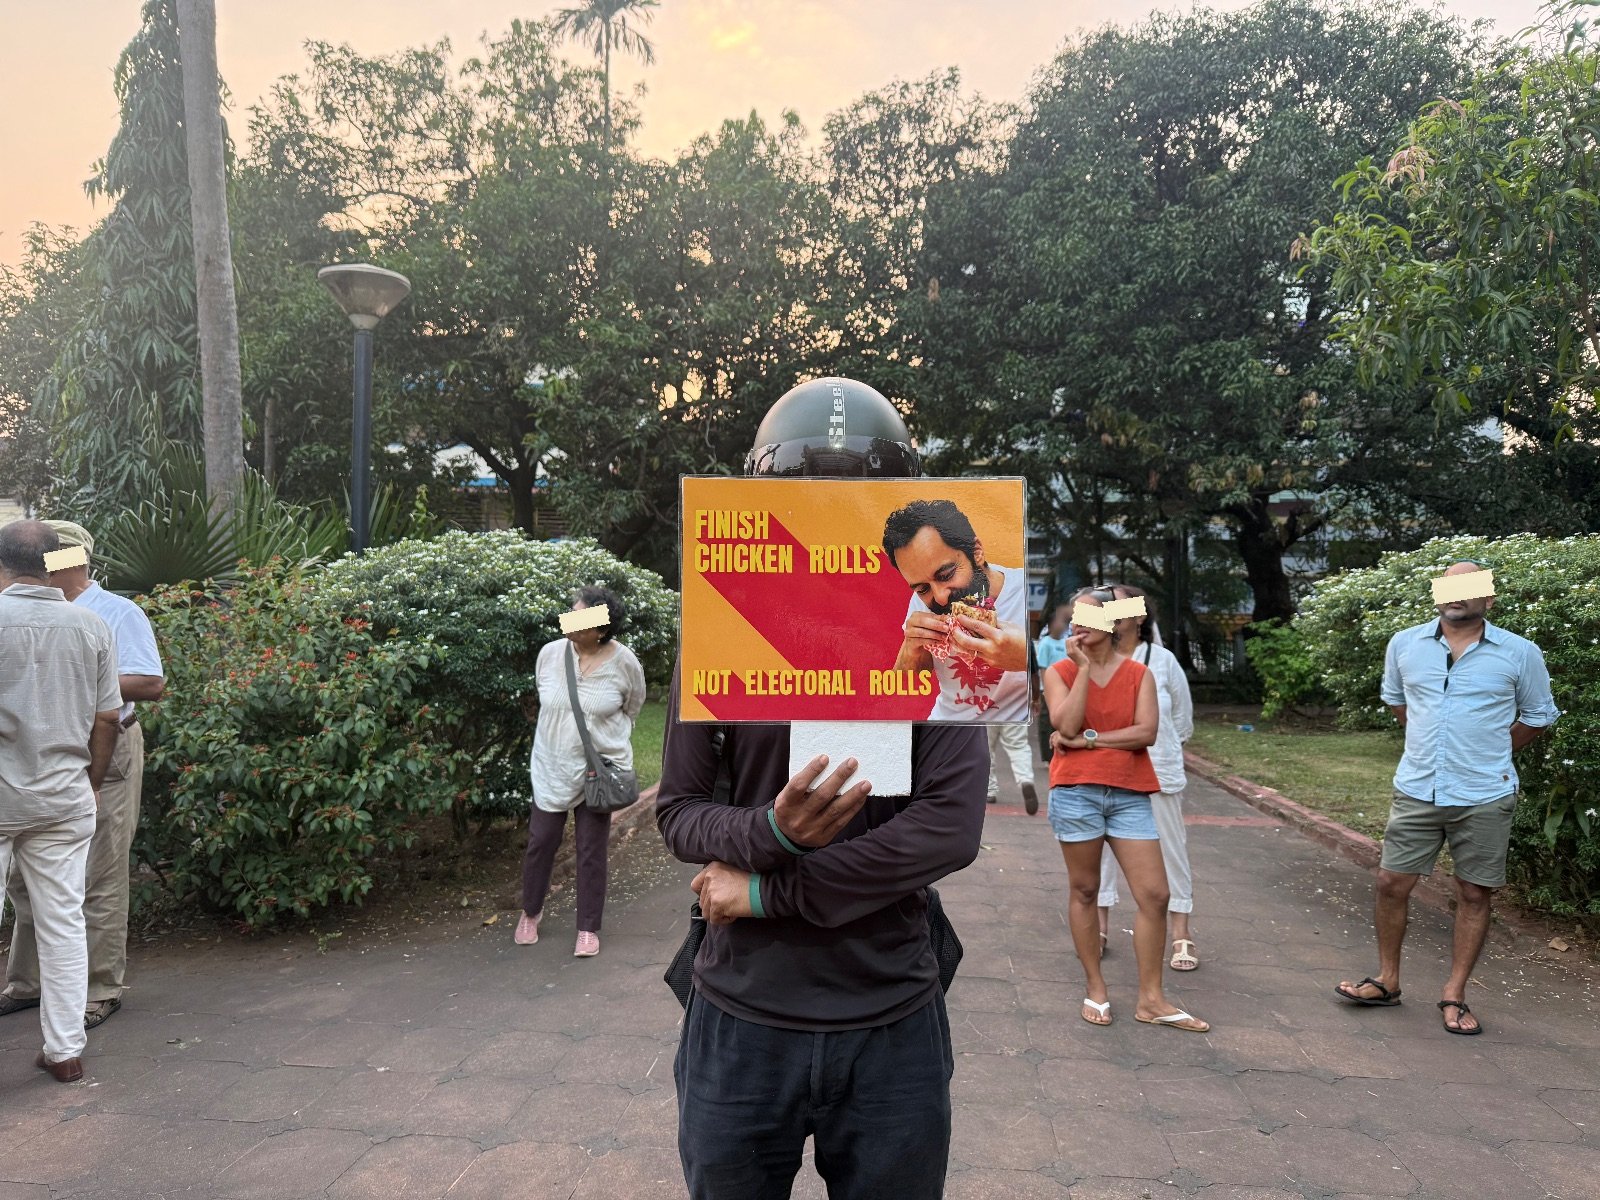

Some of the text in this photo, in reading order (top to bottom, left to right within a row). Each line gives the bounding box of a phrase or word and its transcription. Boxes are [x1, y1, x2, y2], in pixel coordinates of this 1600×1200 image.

[695, 509, 769, 539] FINISH
[694, 543, 881, 573] CHICKEN ROLLS
[692, 669, 932, 695] NOT ELECTORAL ROLLS
